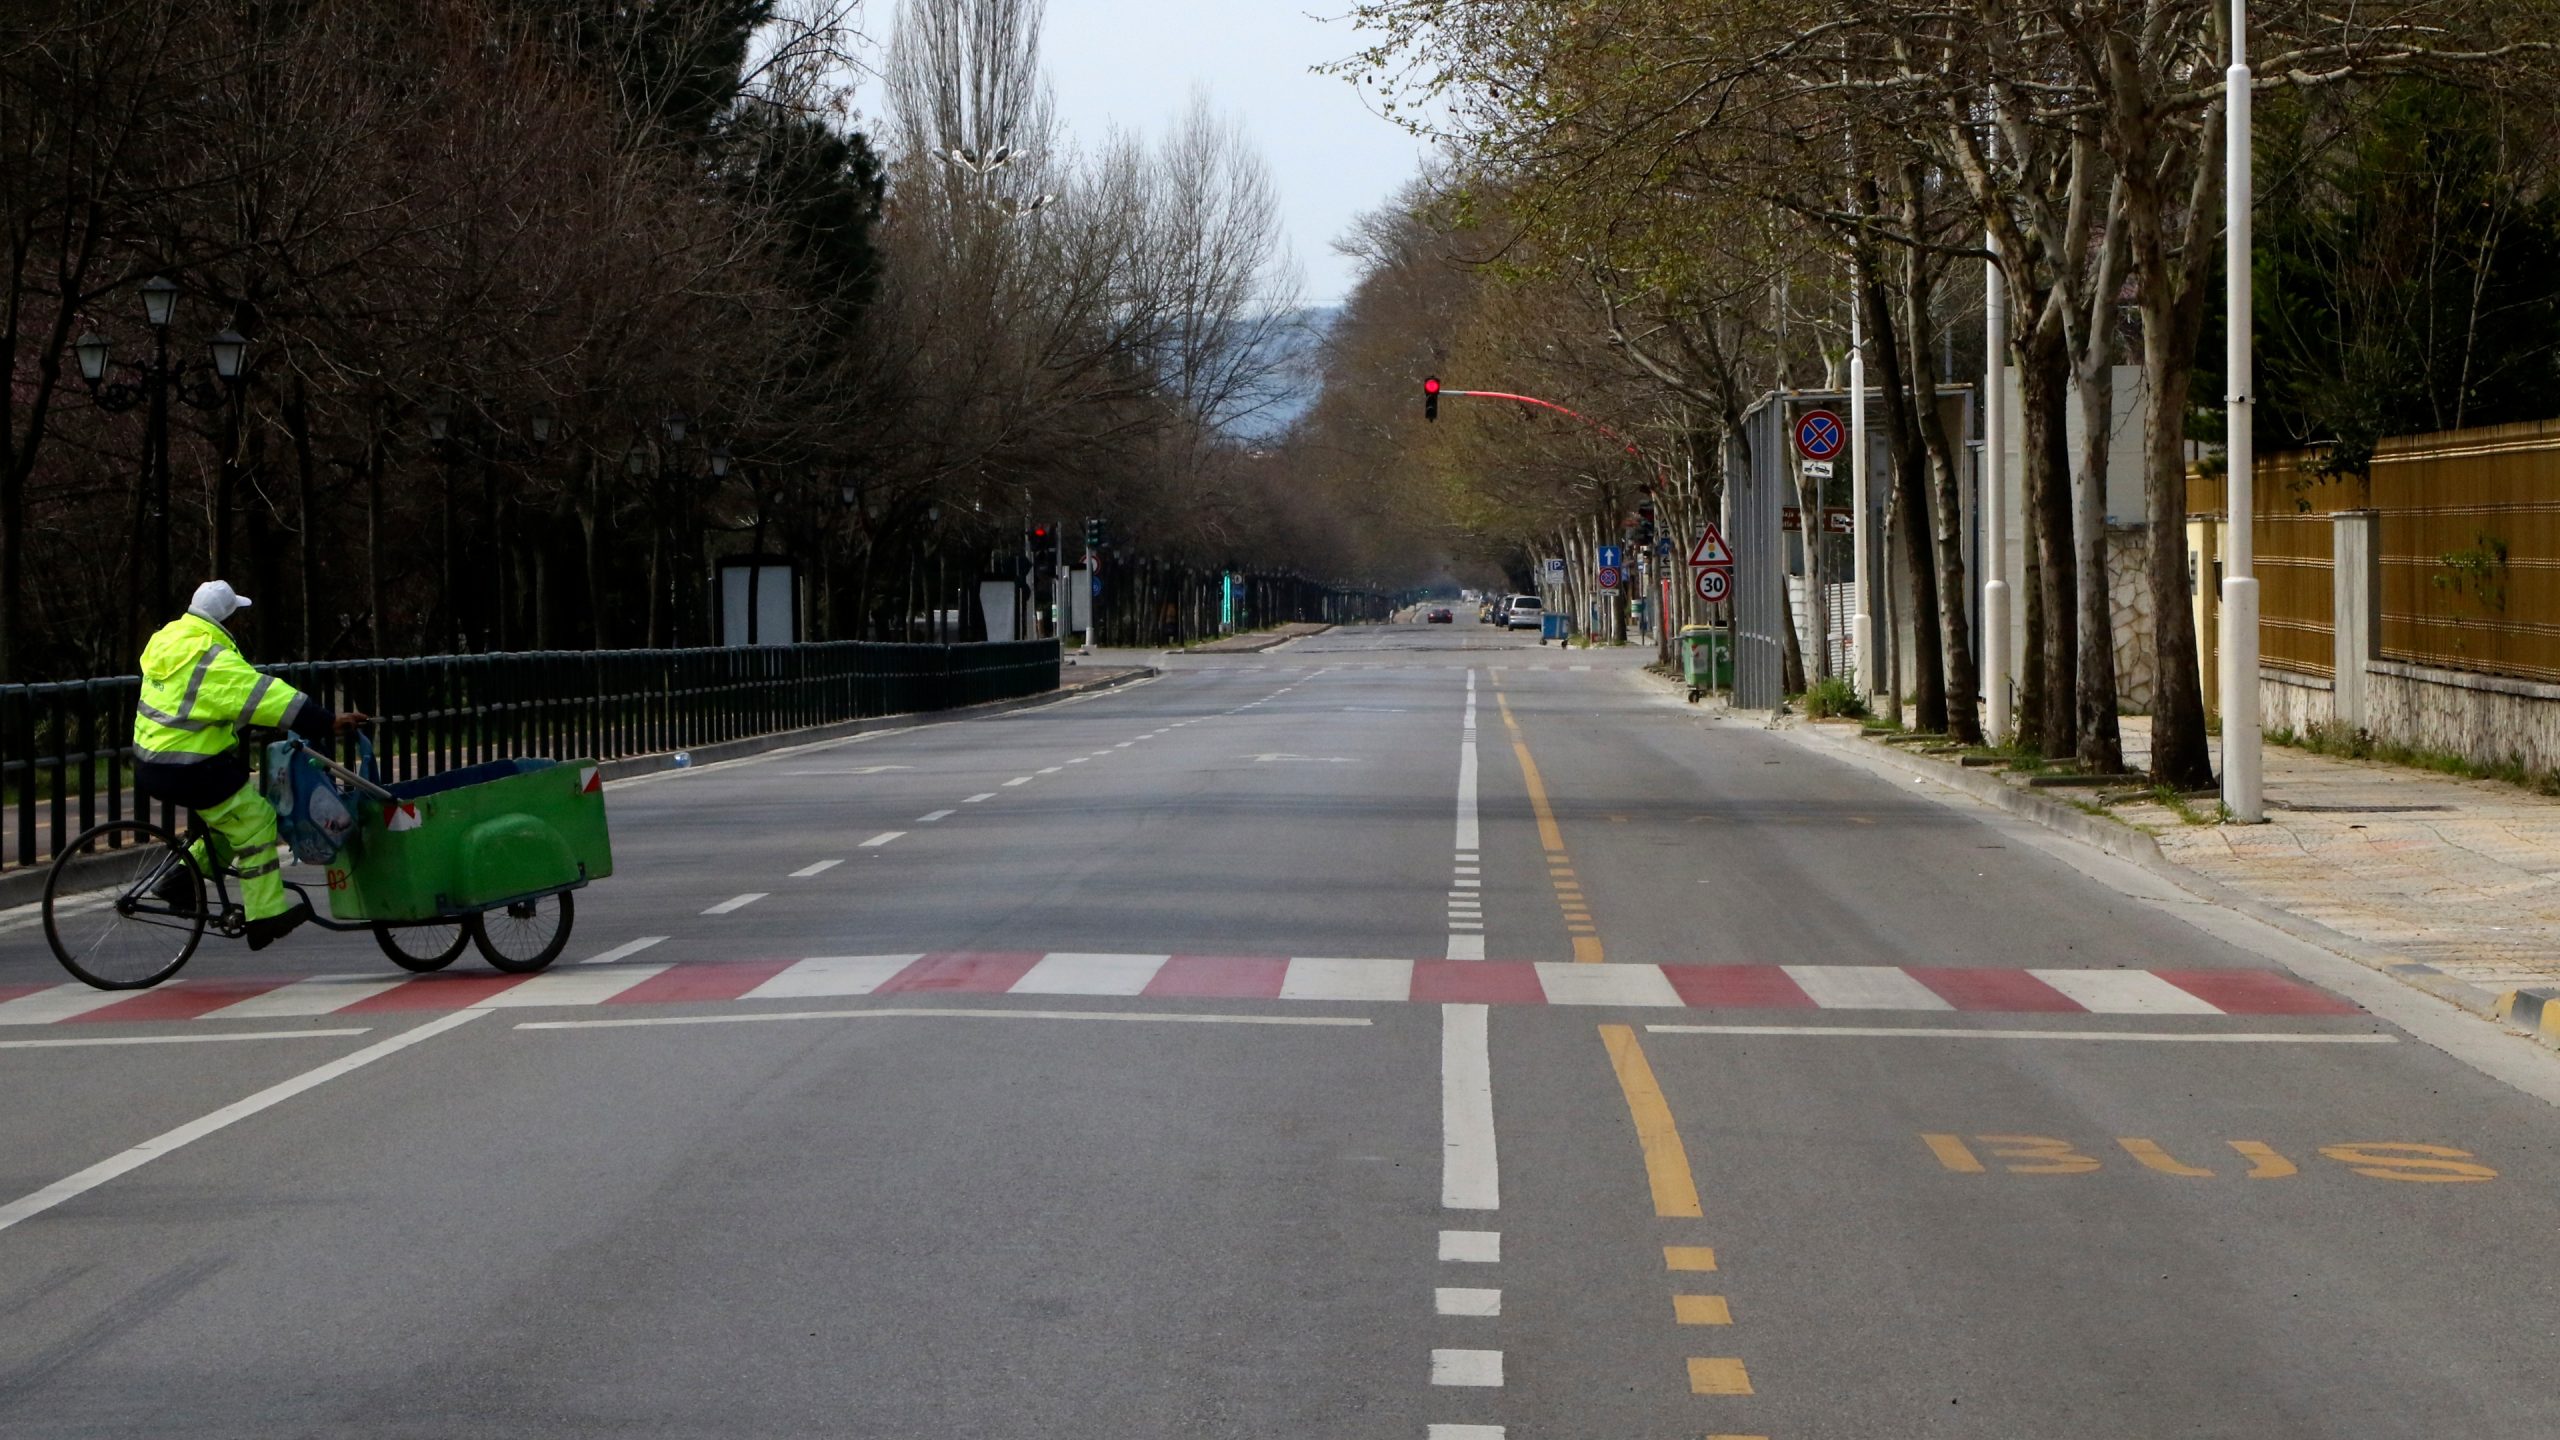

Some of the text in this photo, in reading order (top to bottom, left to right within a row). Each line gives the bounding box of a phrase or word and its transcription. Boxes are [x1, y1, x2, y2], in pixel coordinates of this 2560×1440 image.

[1553, 561, 1562, 570] P
[1703, 577, 1724, 593] 30
[328, 869, 347, 890] 03
[1920, 1133, 2499, 1183] BUS
